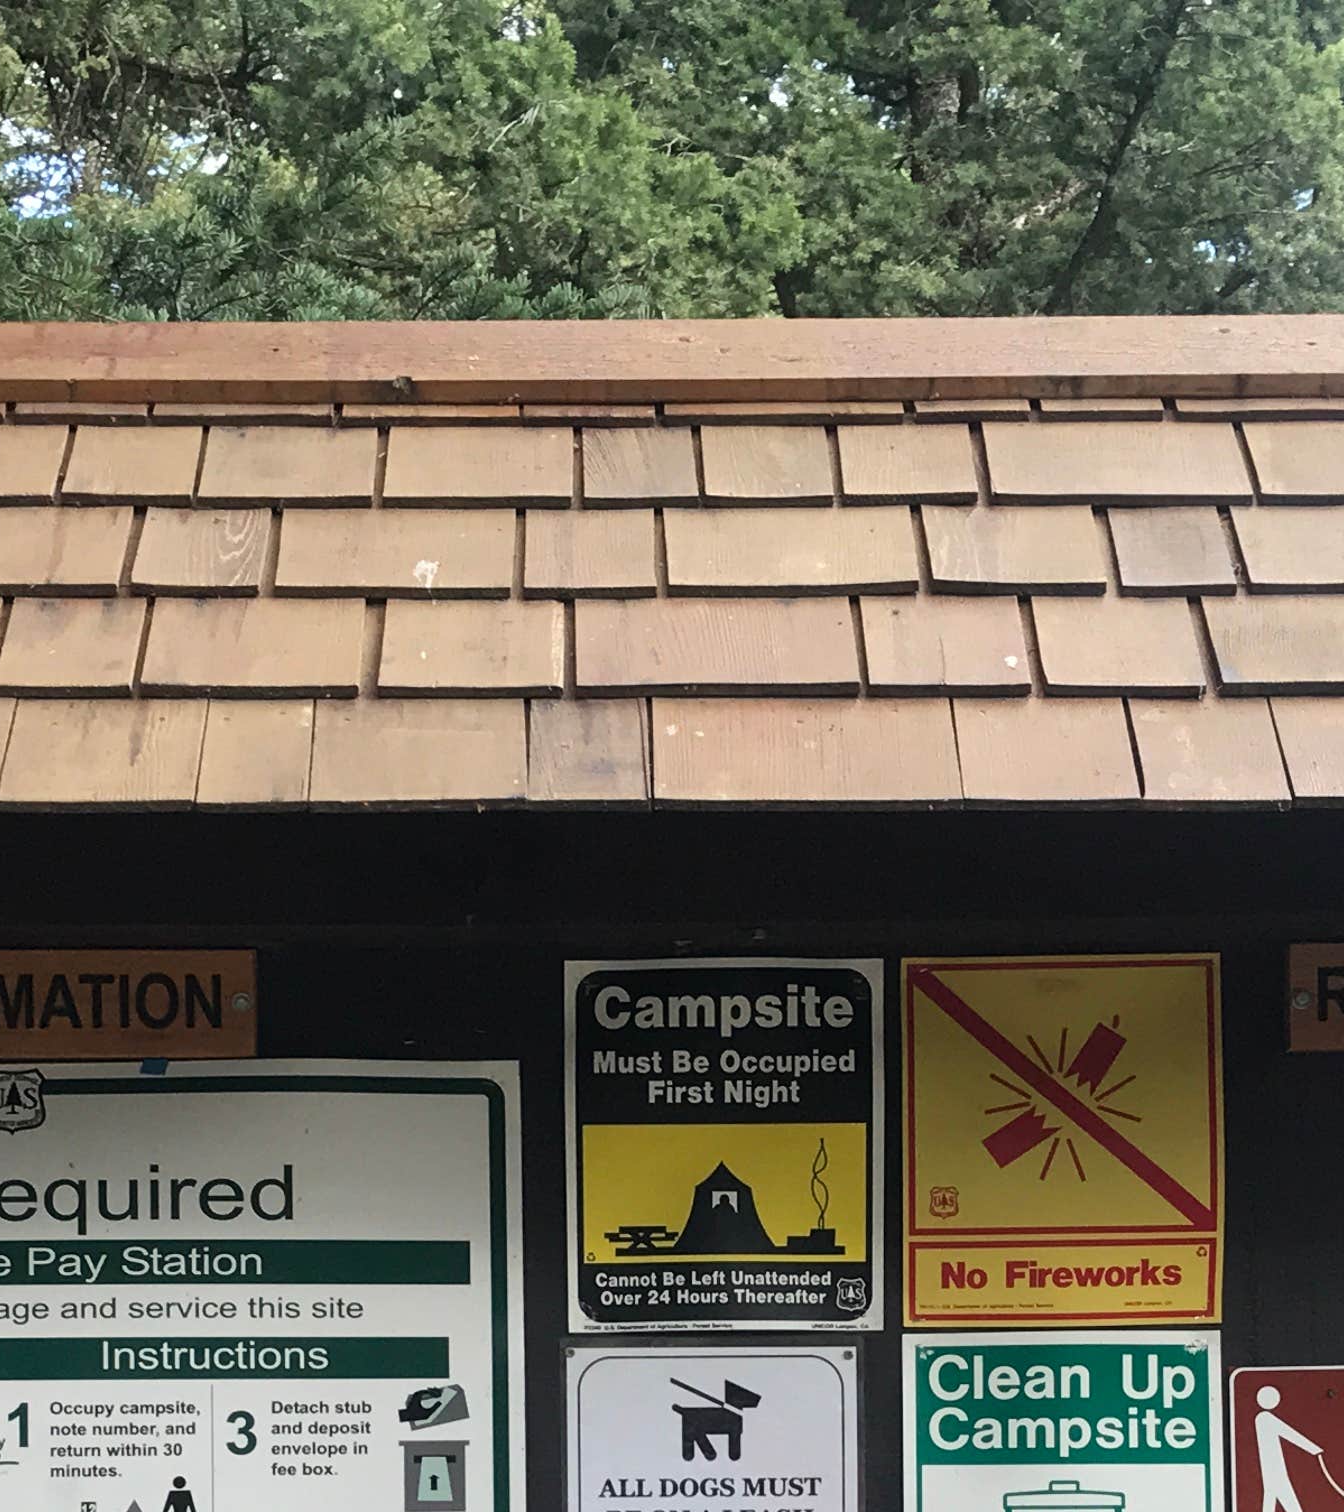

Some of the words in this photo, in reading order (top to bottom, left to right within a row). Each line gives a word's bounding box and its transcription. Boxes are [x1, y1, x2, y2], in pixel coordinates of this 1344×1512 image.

[595, 984, 853, 1037] Campsite
[594, 1051, 662, 1073] Must
[673, 1050, 709, 1073] Be
[720, 1049, 855, 1077] Occupied
[649, 1080, 713, 1103] First
[725, 1080, 800, 1108] Night
[29, 1248, 107, 1283] Pay
[122, 1247, 262, 1275] Station
[596, 1273, 656, 1287] Cannot
[663, 1272, 685, 1285] Be
[692, 1271, 725, 1285] Left
[731, 1271, 831, 1285] Unattended
[941, 1262, 988, 1289] No
[1006, 1259, 1181, 1288] Fireworks
[61, 1297, 116, 1319] and
[128, 1297, 237, 1318] service
[248, 1297, 300, 1318] this
[312, 1297, 363, 1318] site
[601, 1291, 641, 1305] Over
[648, 1290, 670, 1304] 24
[678, 1289, 728, 1303] Hours
[734, 1289, 826, 1304] Thereafter
[103, 1341, 328, 1369] Instructions
[929, 1355, 1091, 1400] Clean
[1123, 1354, 1196, 1408] Up
[928, 1409, 1196, 1457] Campsite
[599, 1479, 652, 1497] ALL
[659, 1478, 735, 1497] DOGS
[743, 1477, 822, 1496] MUST
